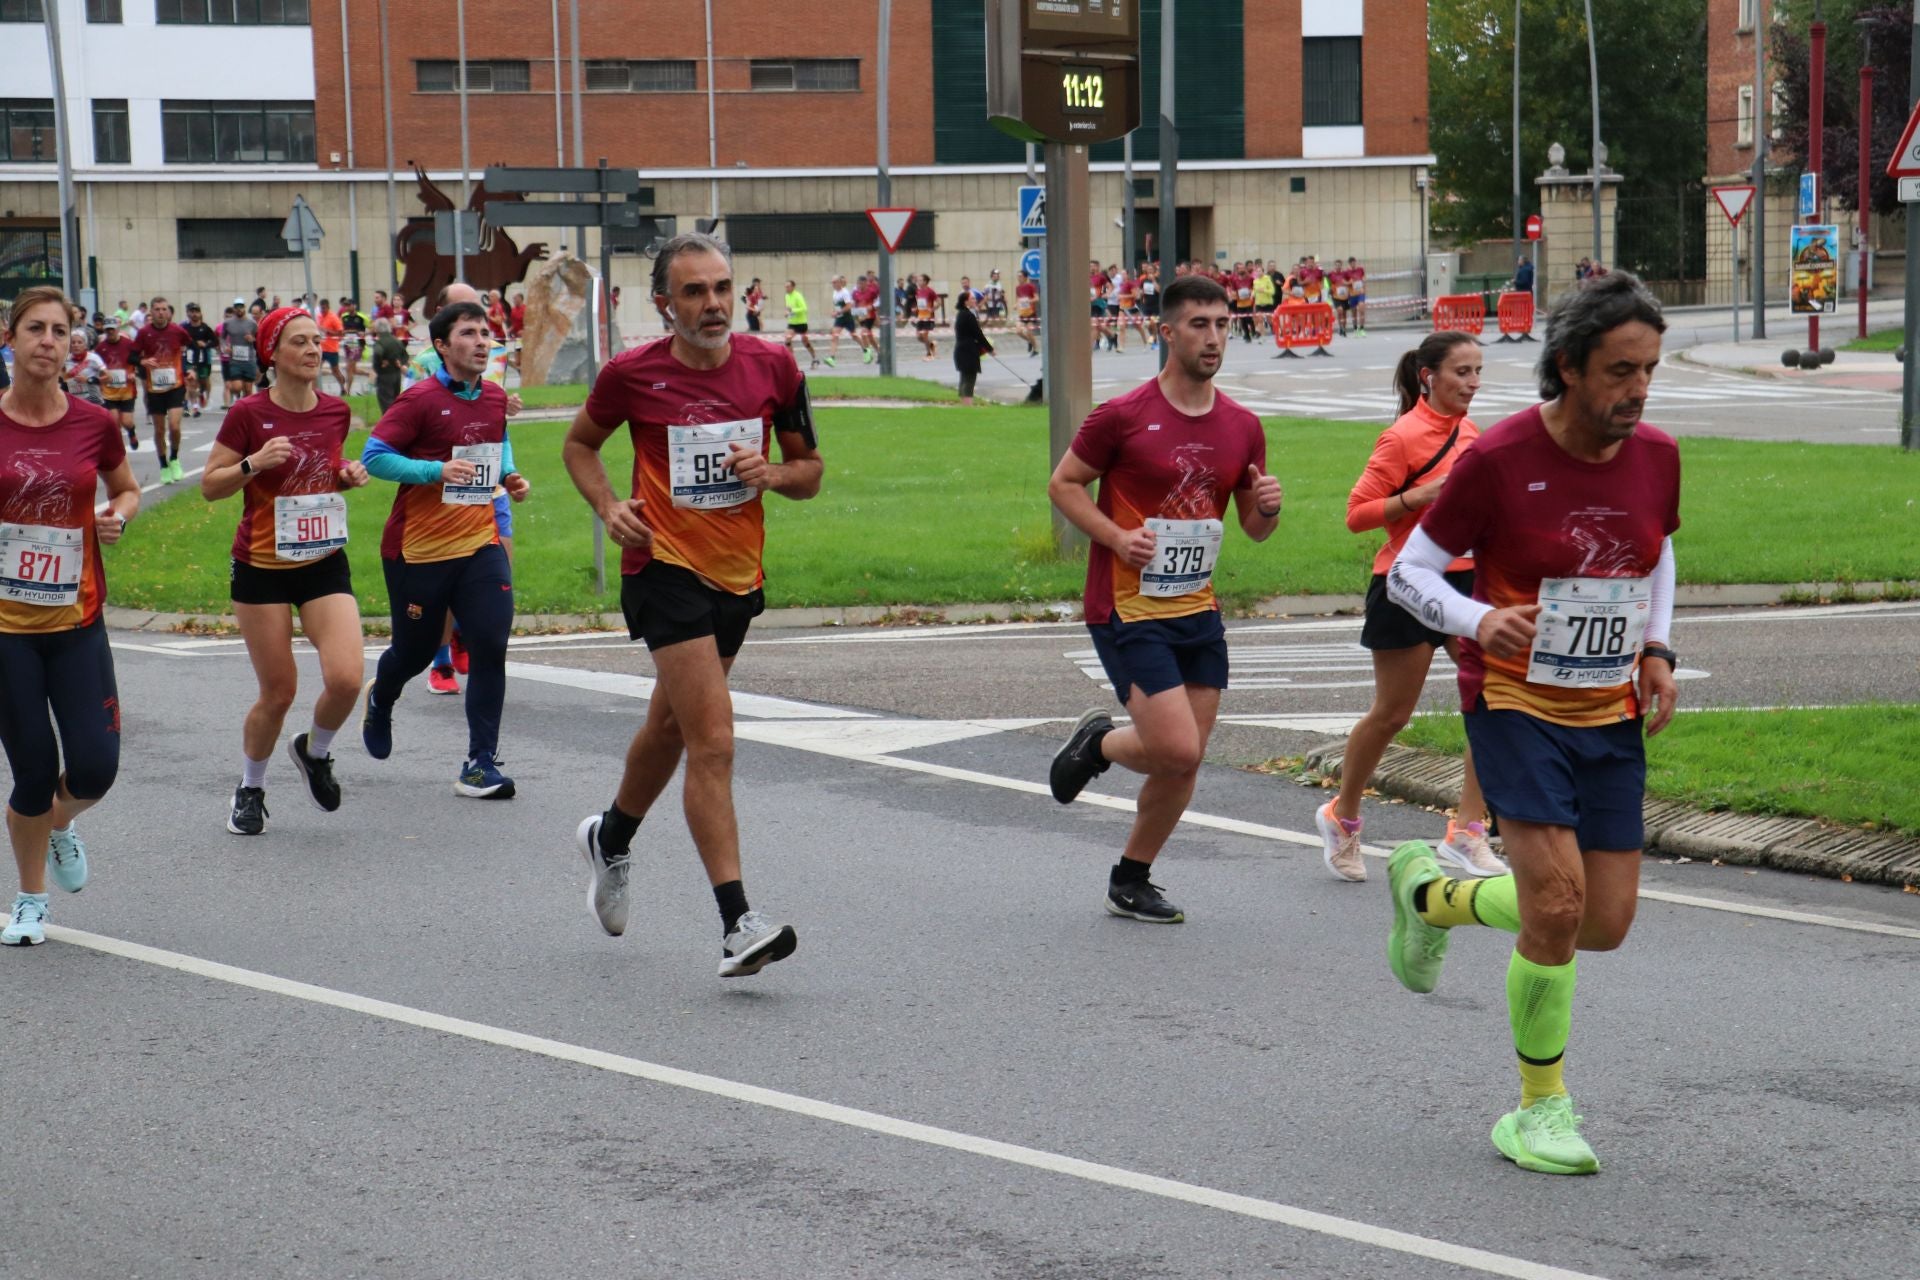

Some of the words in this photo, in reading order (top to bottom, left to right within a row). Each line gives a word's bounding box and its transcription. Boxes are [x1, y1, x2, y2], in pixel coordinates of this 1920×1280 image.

[1063, 74, 1104, 107] 11:12
[297, 515, 329, 542] 901
[18, 550, 61, 583] 871
[1163, 546, 1205, 574] 379
[24, 591, 66, 600] HYUNDAI
[1583, 605, 1620, 615] VAZQUEZ
[1567, 616, 1628, 656] 708
